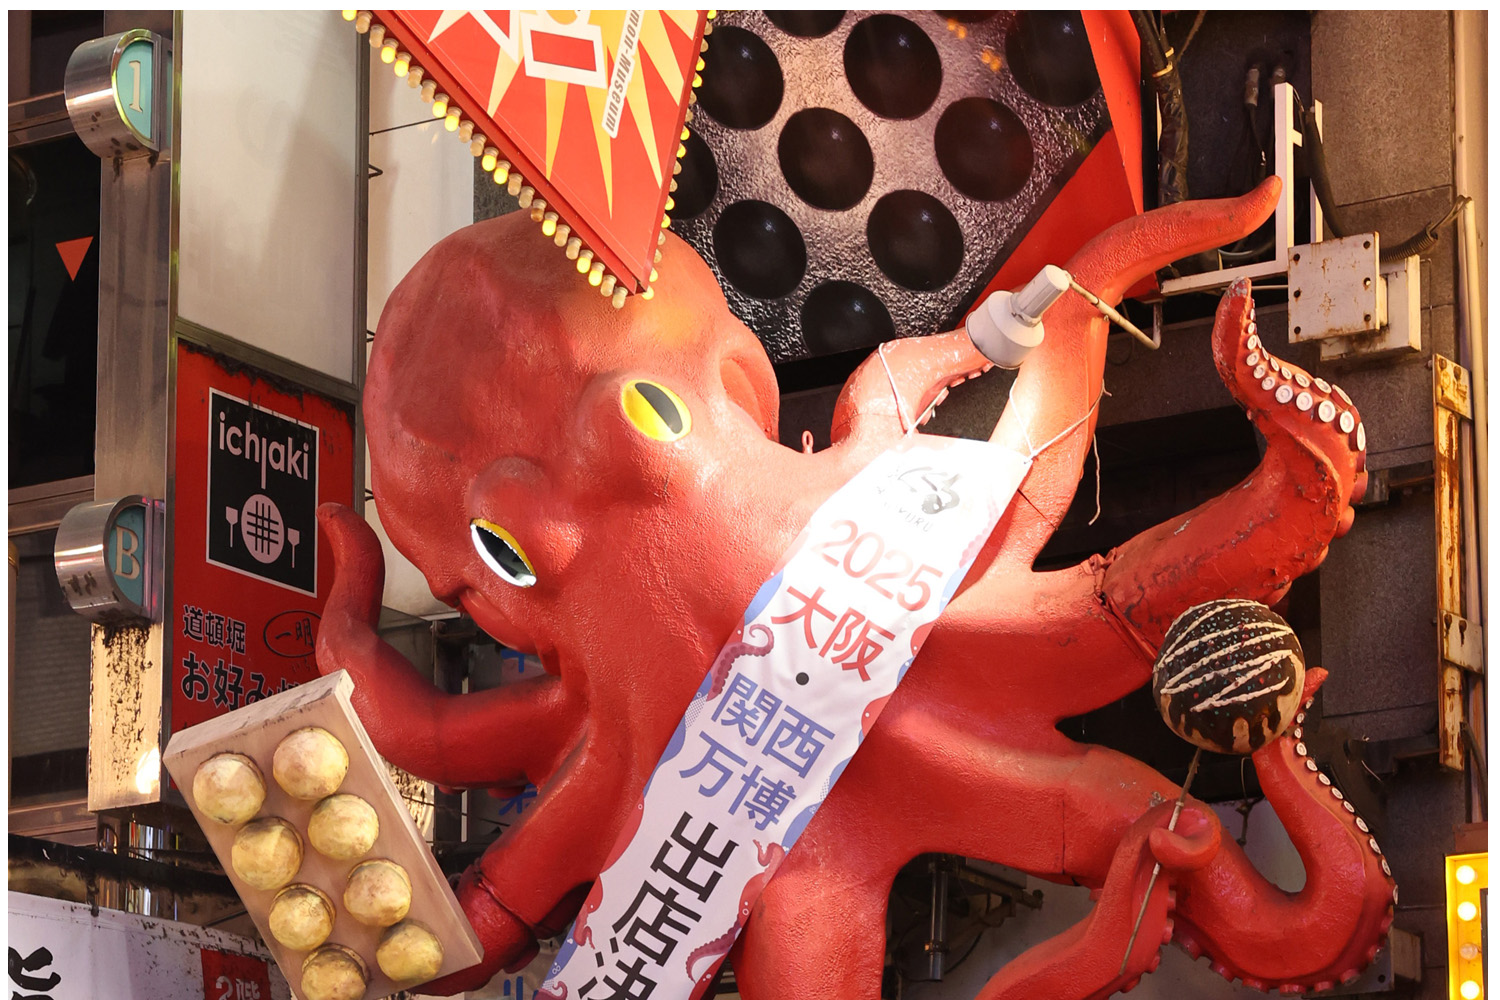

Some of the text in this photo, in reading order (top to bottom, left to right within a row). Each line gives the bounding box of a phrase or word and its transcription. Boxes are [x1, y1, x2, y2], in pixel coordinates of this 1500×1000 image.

[605, 10, 640, 131] mon-Museum
[116, 526, 141, 580] B
[811, 518, 943, 613] 2025
[183, 605, 246, 655] 道頓堀
[771, 584, 896, 682] 大阪
[710, 672, 834, 778] 関西
[679, 729, 798, 831] 万博
